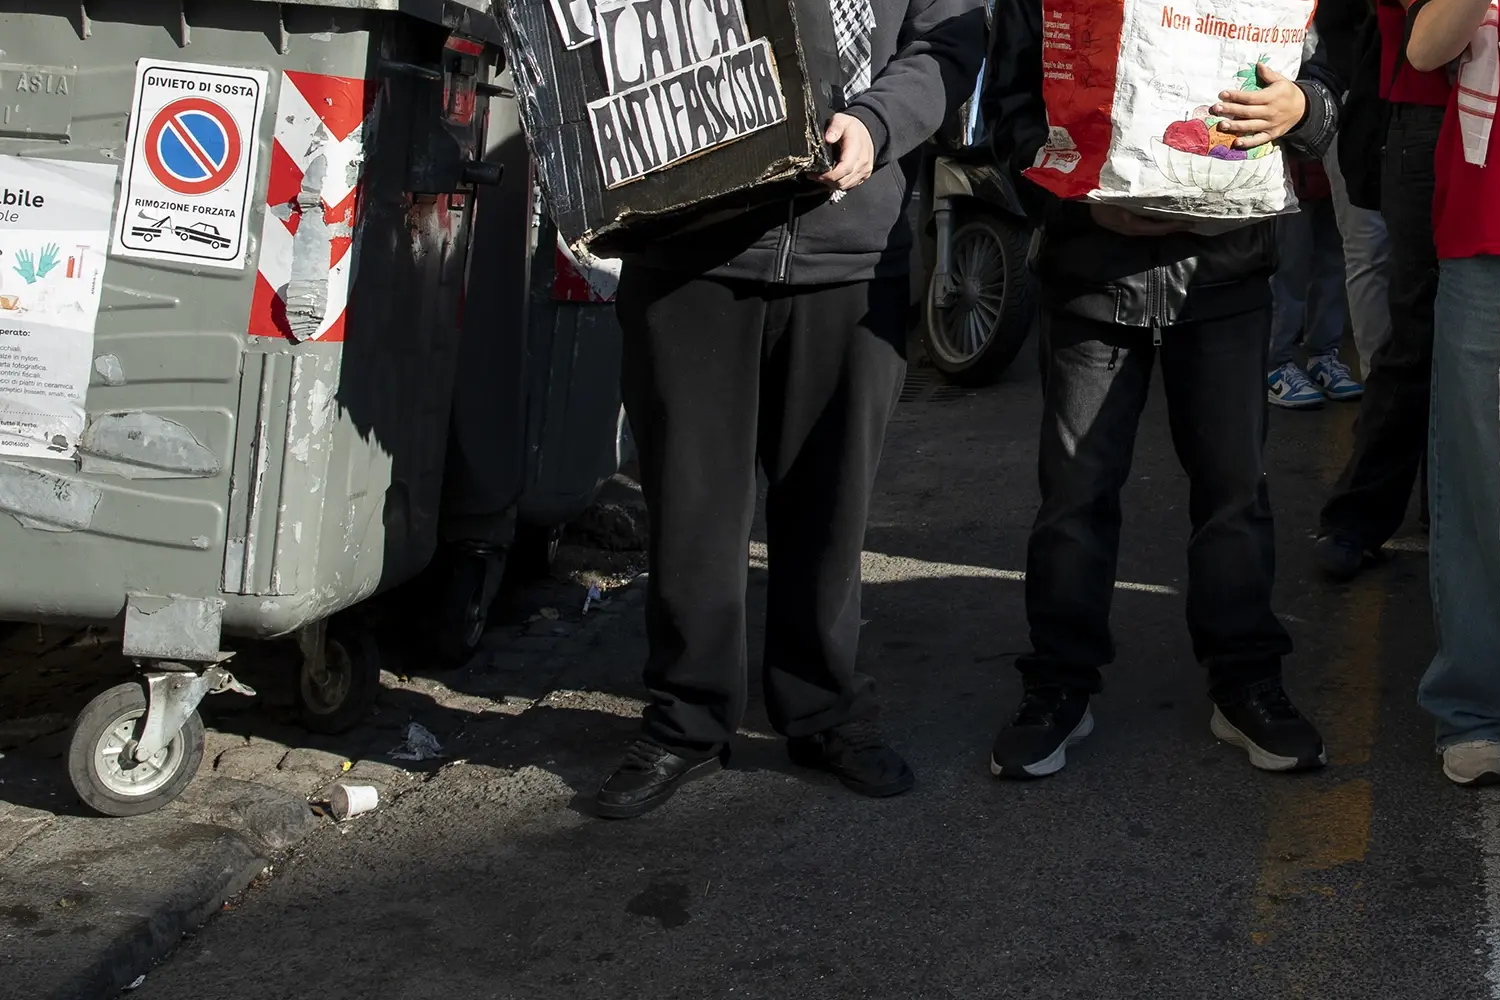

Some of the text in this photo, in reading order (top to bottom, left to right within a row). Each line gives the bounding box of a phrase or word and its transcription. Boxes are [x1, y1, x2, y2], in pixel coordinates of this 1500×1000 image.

[1161, 6, 1191, 30] Non
[1194, 14, 1271, 43] alimentare
[16, 72, 69, 96] ASIA
[147, 76, 254, 97] DIVIETO DI SOSTA
[591, 39, 785, 182] ANTIFASCISTA
[0, 188, 44, 208] bile
[134, 198, 236, 218] RIMOZIONE FORZATA
